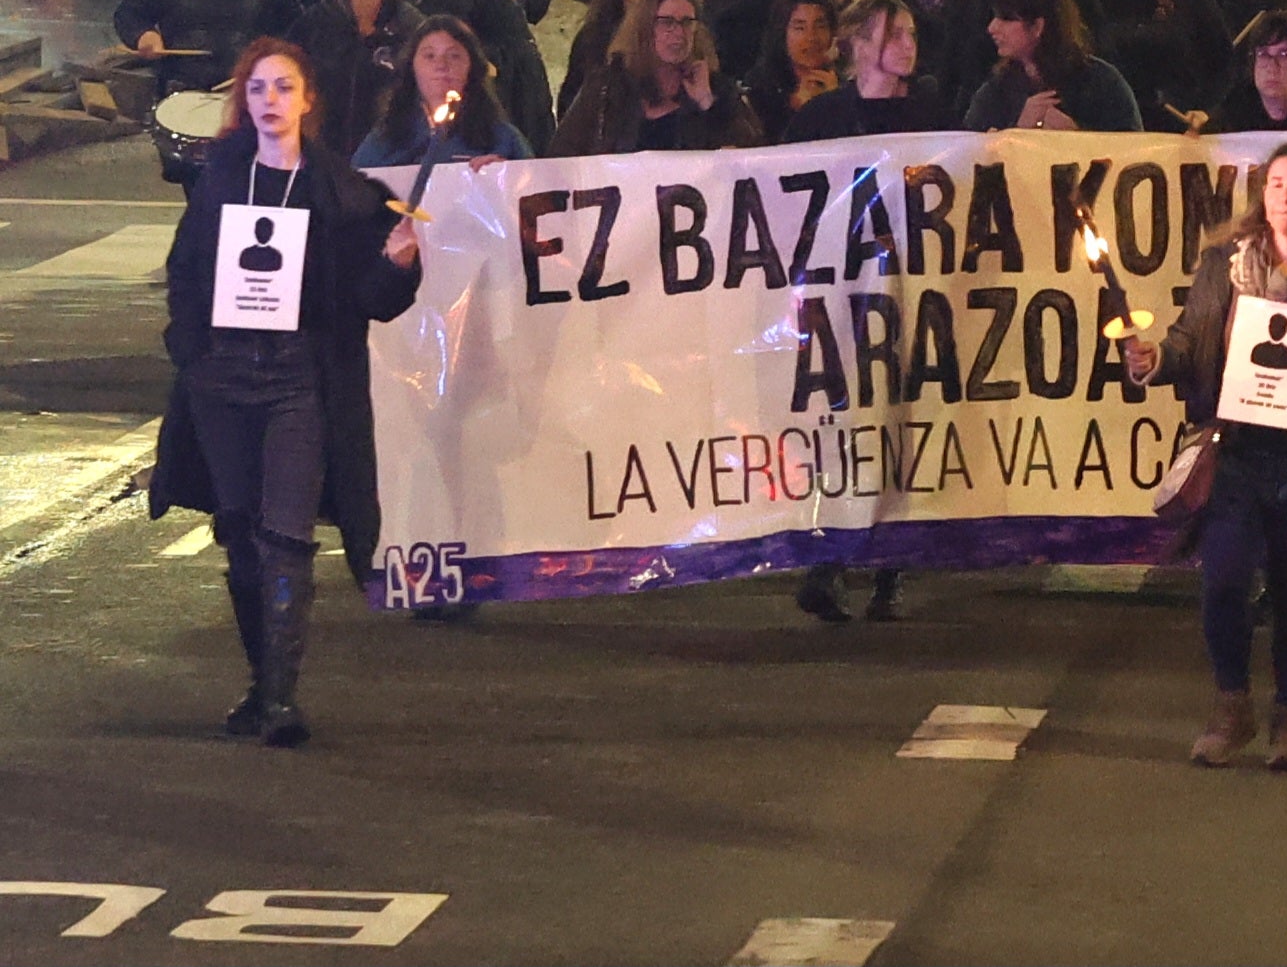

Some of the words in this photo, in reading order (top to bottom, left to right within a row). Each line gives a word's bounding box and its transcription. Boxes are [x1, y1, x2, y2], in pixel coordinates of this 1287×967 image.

[519, 185, 630, 306] EZ
[656, 161, 1025, 296] BAZARA
[586, 443, 657, 521] LA
[665, 415, 974, 511] VERGÜENZA
[989, 415, 1057, 492] VA
[1074, 418, 1112, 492] A
[384, 541, 467, 609] A25
